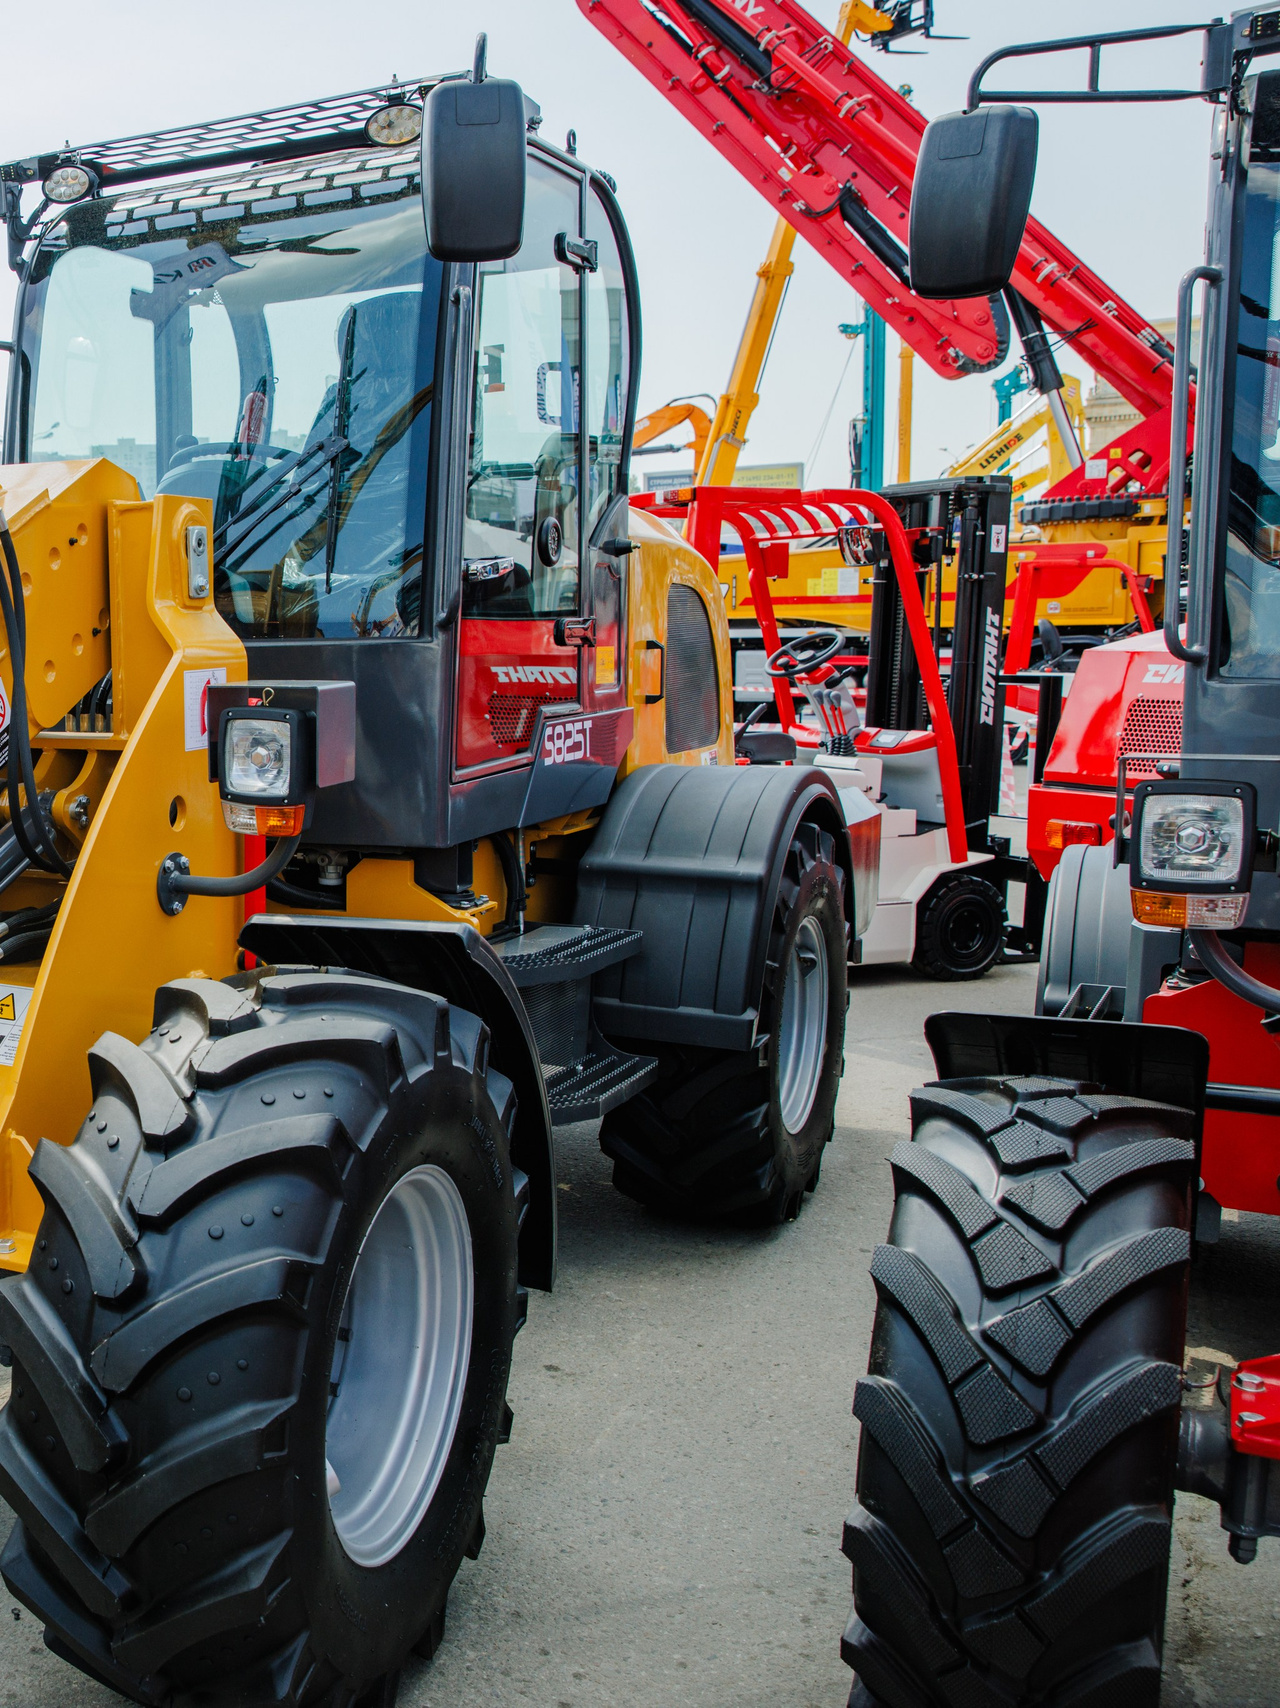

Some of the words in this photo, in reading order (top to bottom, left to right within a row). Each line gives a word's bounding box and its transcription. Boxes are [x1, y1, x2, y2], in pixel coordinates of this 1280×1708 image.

[730, 408, 742, 437] DIECI
[979, 432, 1024, 470] LISHIDE
[544, 720, 592, 766] S825T
